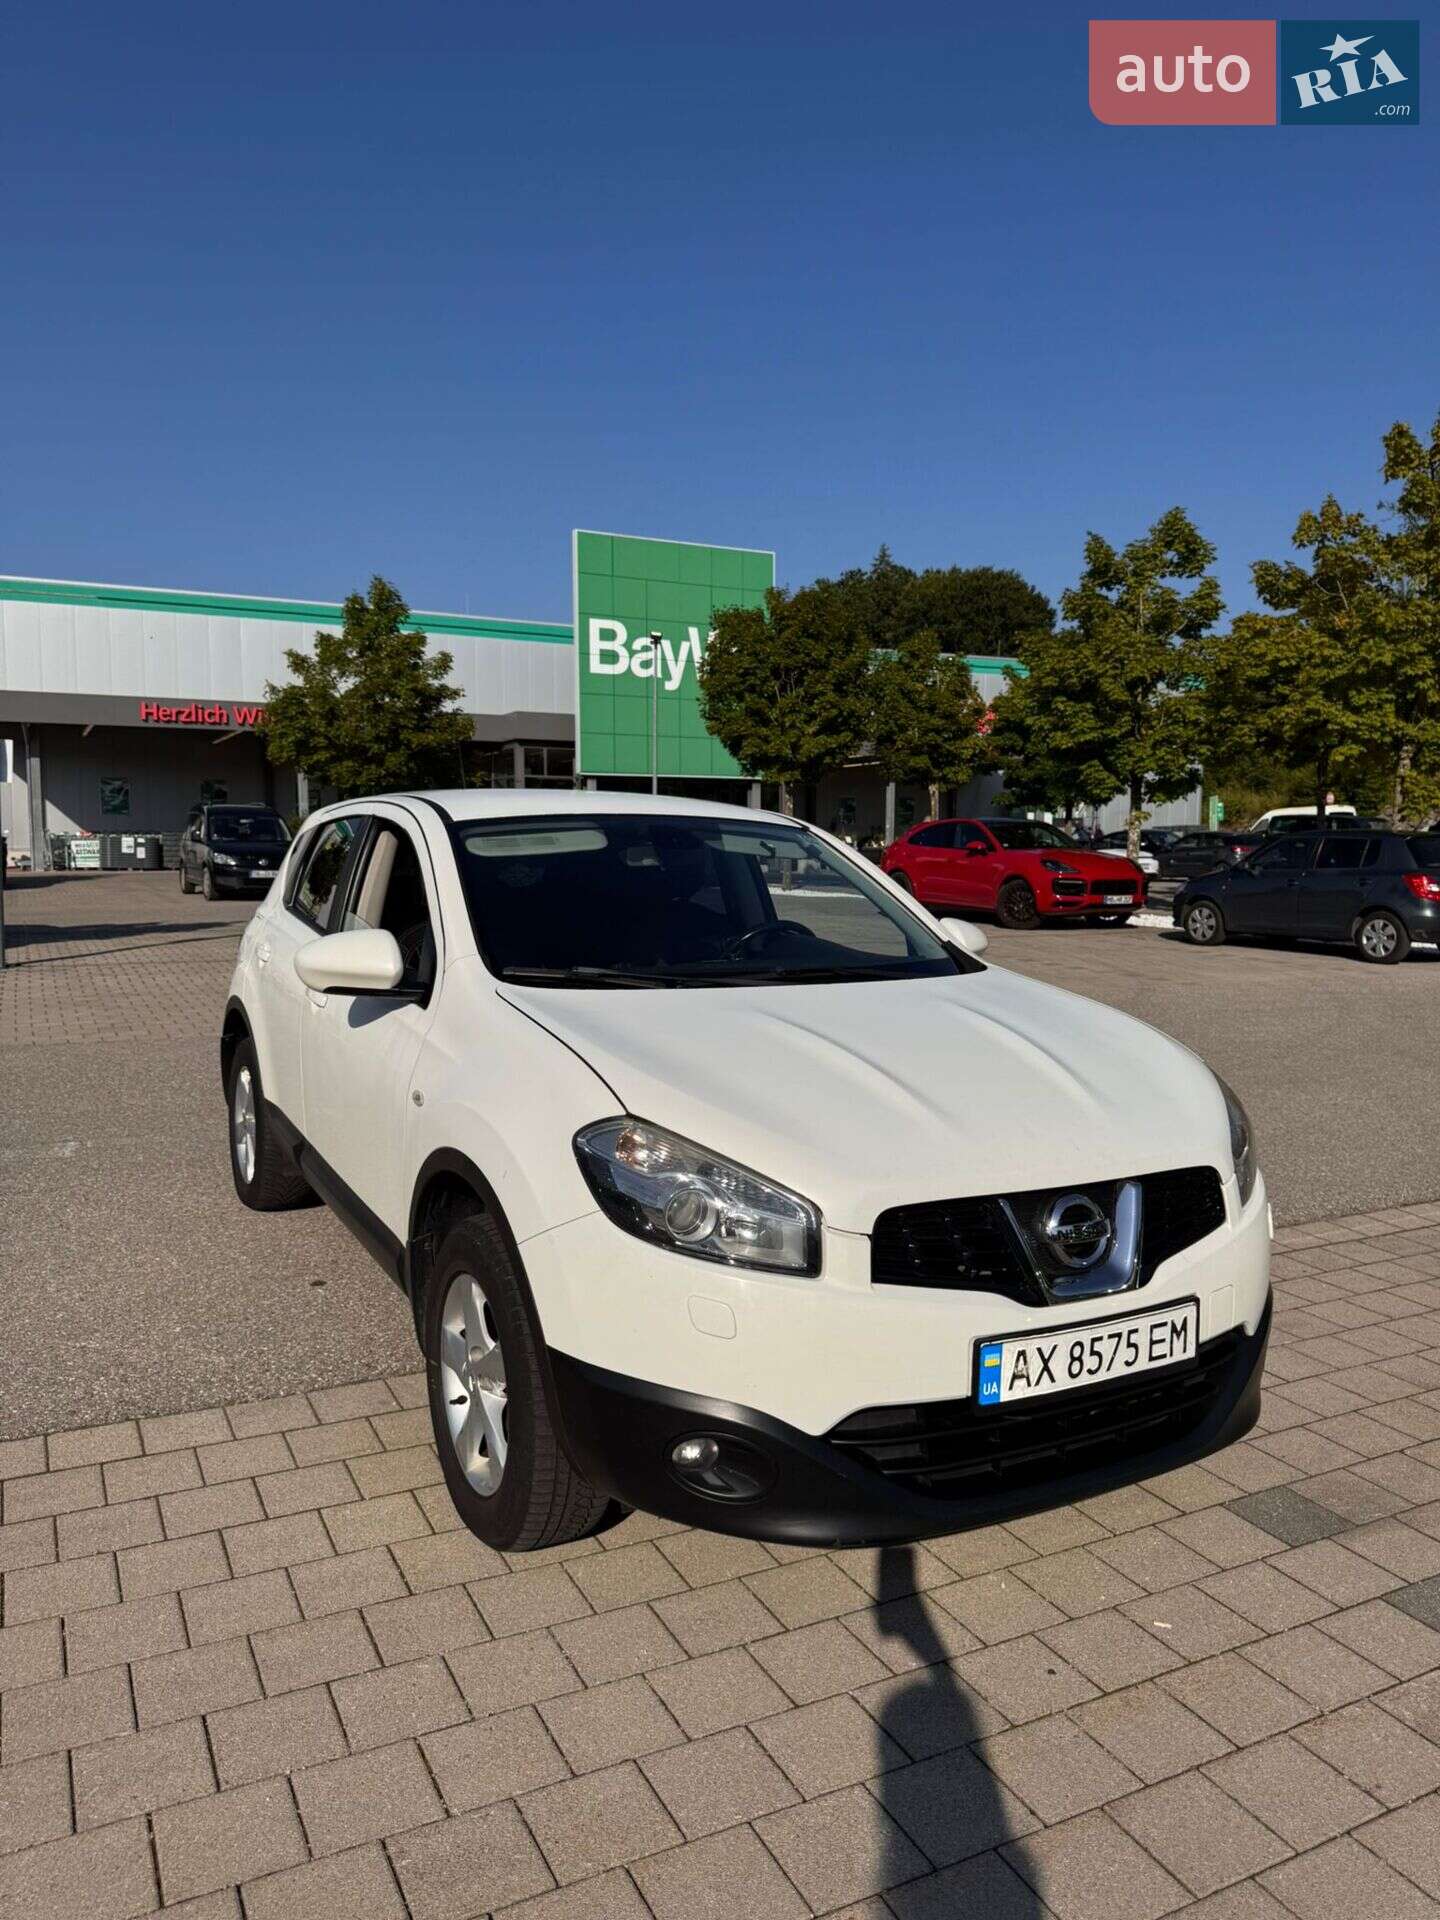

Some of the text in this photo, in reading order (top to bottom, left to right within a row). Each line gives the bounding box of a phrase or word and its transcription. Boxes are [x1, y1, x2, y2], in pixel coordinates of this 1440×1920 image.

[140, 702, 228, 725] Herzlich
[1008, 1316, 1188, 1391] AX 8575 EM
[983, 1382, 999, 1396] UA
